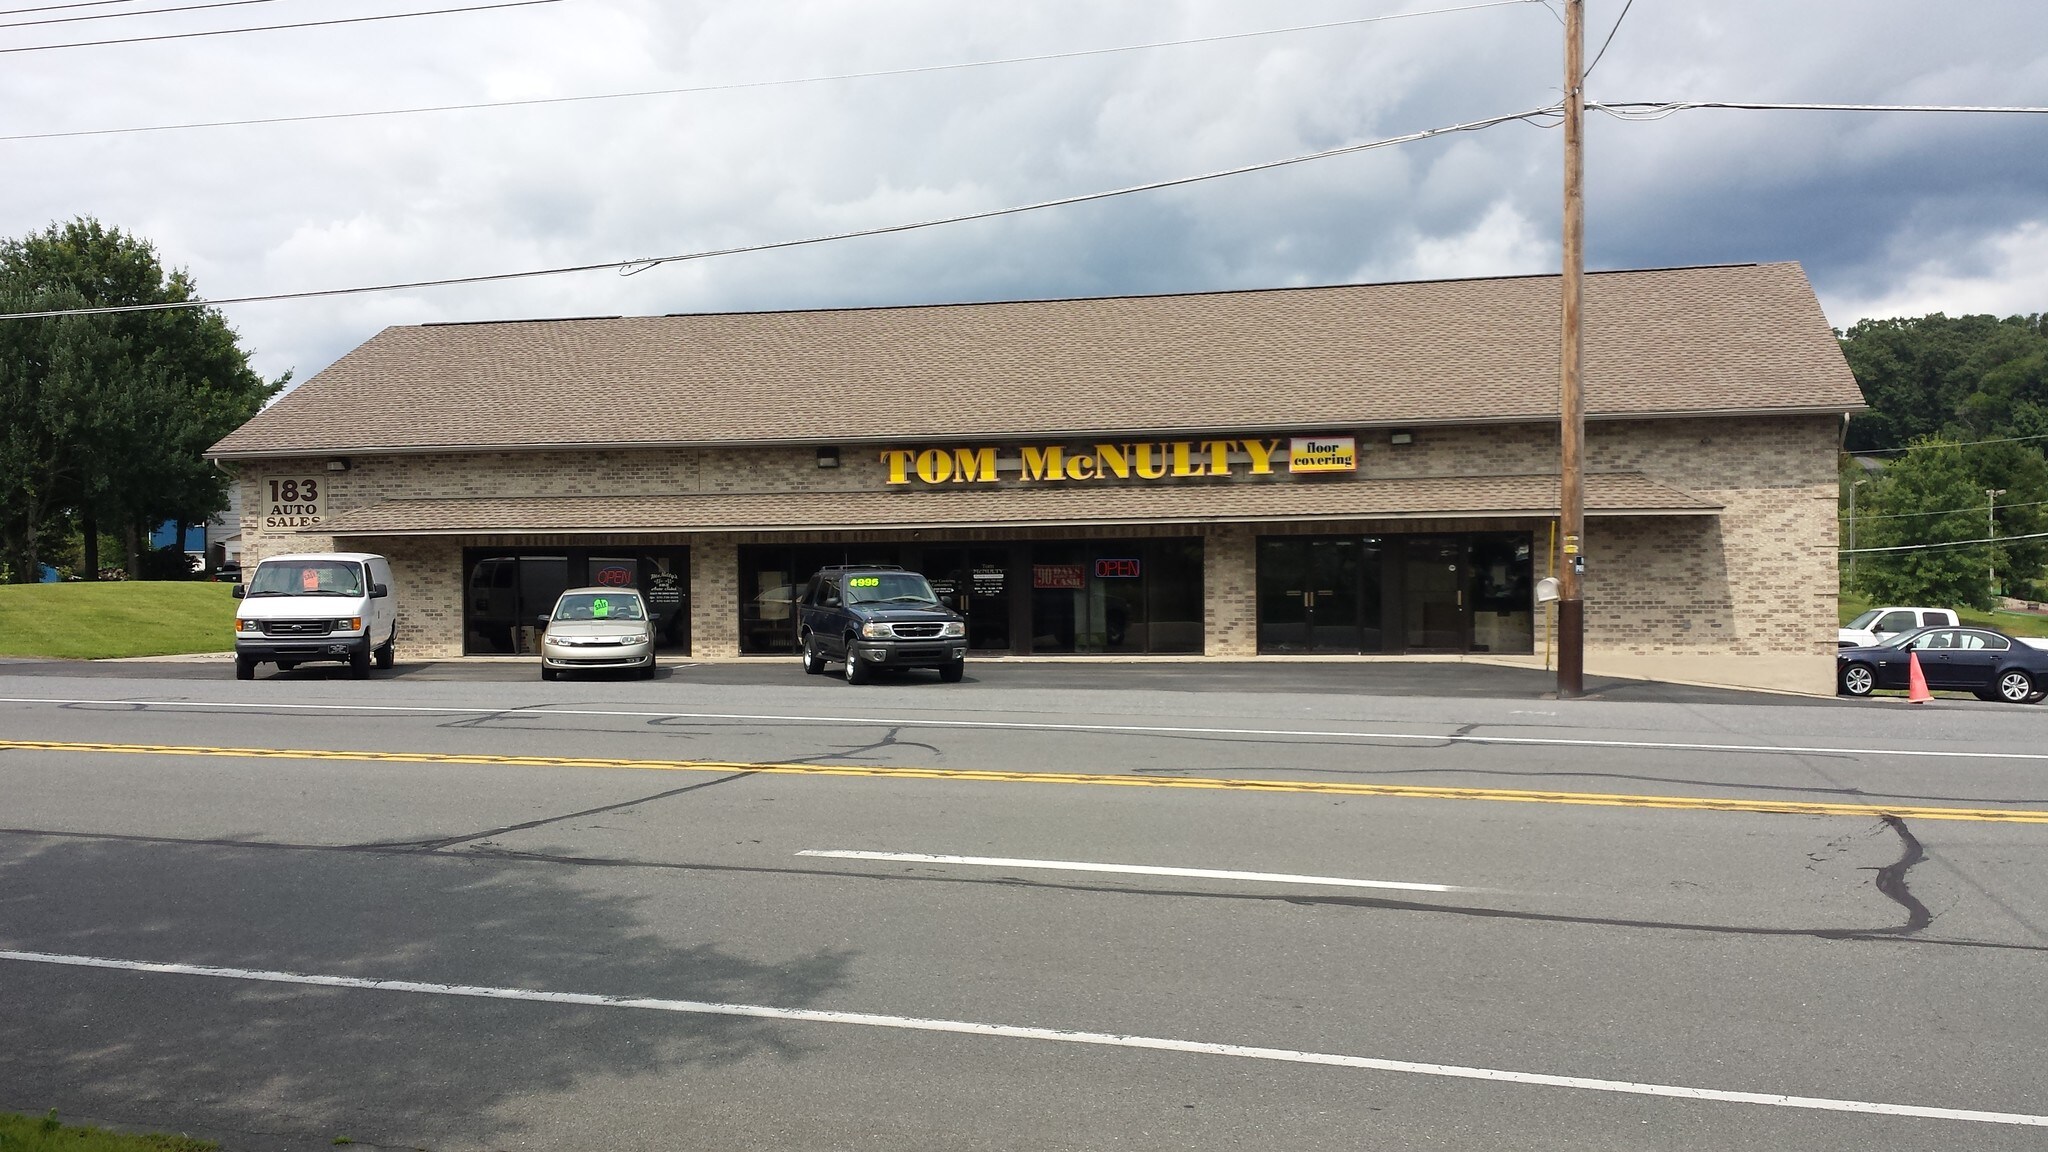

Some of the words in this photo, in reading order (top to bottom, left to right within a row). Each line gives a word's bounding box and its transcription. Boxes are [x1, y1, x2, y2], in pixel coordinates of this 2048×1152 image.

[1307, 442, 1339, 453] floor
[880, 447, 1000, 484] TOM
[1019, 438, 1281, 482] McNULTY
[1294, 453, 1353, 468] covering
[268, 479, 319, 502] 183
[271, 504, 317, 515] AUTO
[1097, 560, 1139, 577] OPEN
[598, 570, 632, 585] OPEN
[850, 578, 879, 587] 4995
